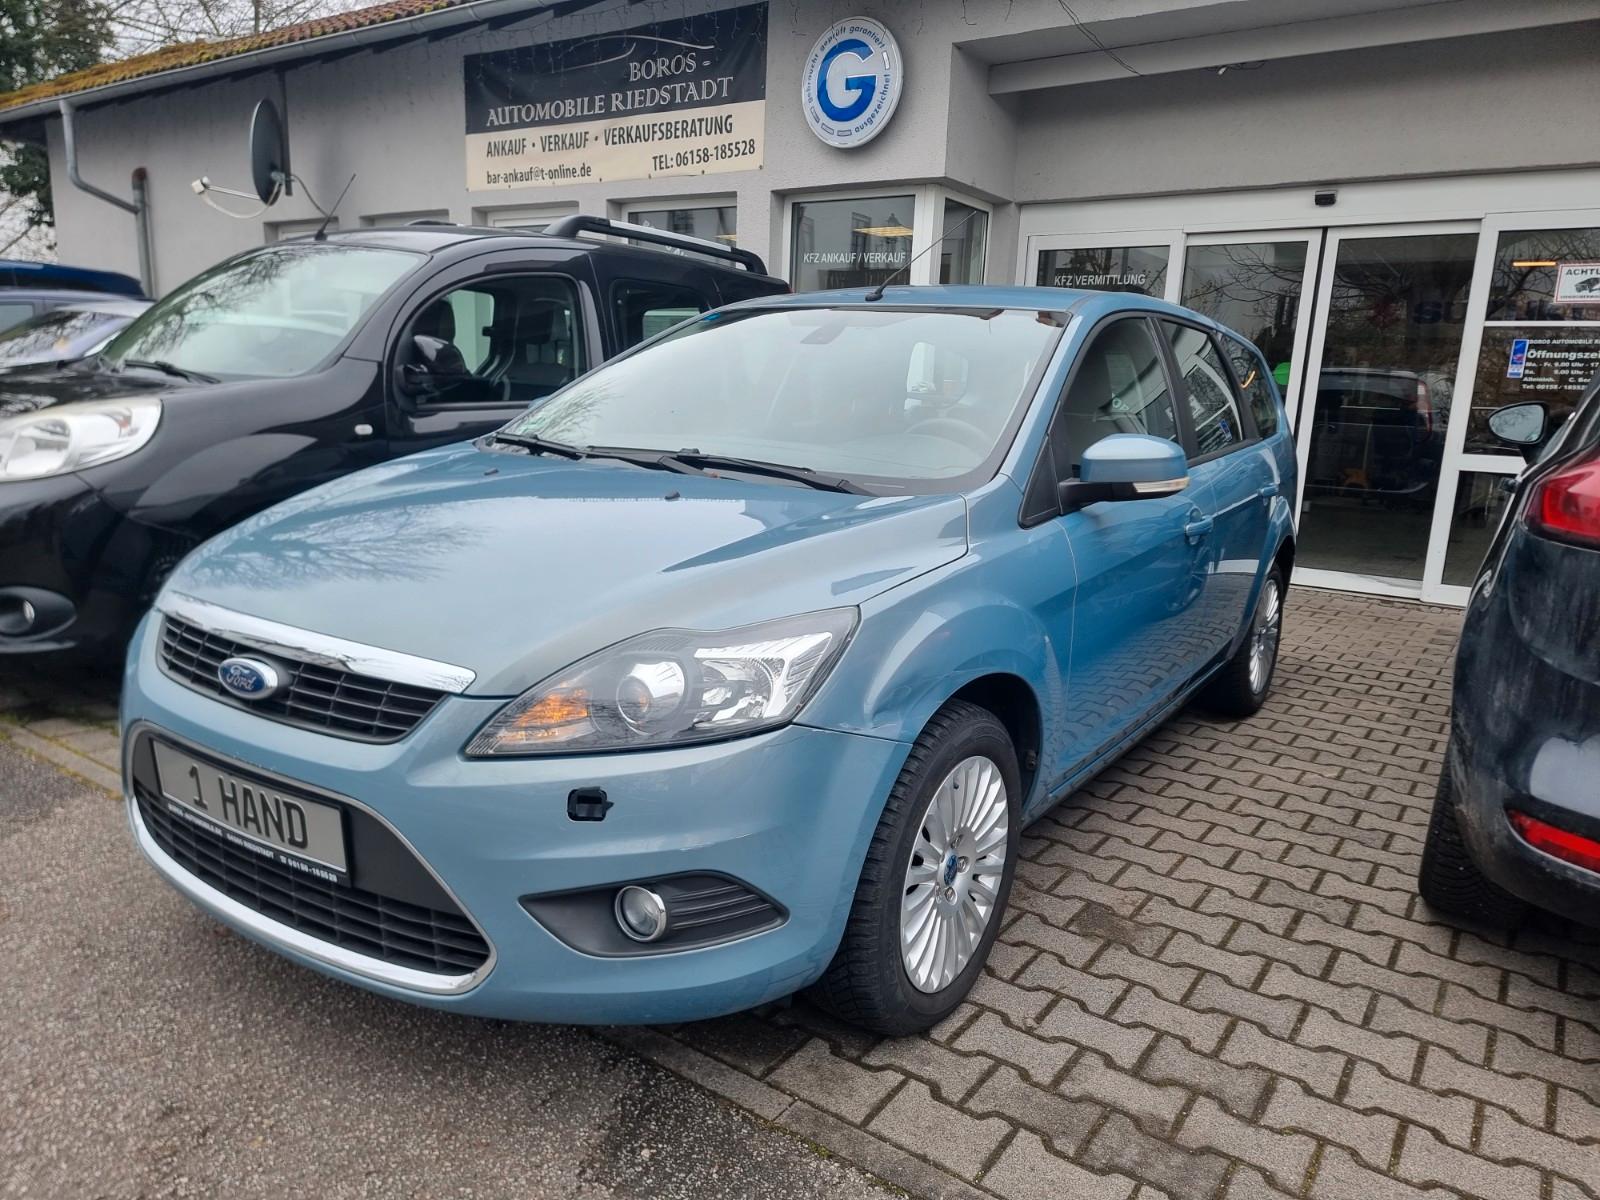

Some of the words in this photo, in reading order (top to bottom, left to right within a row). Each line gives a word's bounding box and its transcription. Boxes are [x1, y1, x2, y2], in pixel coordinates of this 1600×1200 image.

[849, 25, 885, 49] garantiert
[628, 51, 697, 82] BOROS
[486, 94, 605, 127] AUTOMOBILE
[610, 76, 734, 112] RIEDSTADT
[854, 73, 891, 133] ausgezeichnet
[486, 138, 527, 158] ANKAUF
[539, 131, 589, 153] VERKAUF
[603, 114, 733, 146] VERKAUFSBERATUNG
[652, 154, 674, 171] TEL:
[675, 138, 756, 168] 06158-185528
[486, 162, 592, 185] bar-ankauf@t-online.de
[803, 252, 820, 264] KFZ
[821, 251, 857, 264] ANKAUF
[863, 251, 906, 264] VERKAUF
[1054, 275, 1073, 286] KFZ
[1075, 273, 1146, 286] VERMITTLUNG
[226, 664, 257, 691] Ford
[189, 763, 208, 810] 1
[218, 774, 308, 849] HAND
